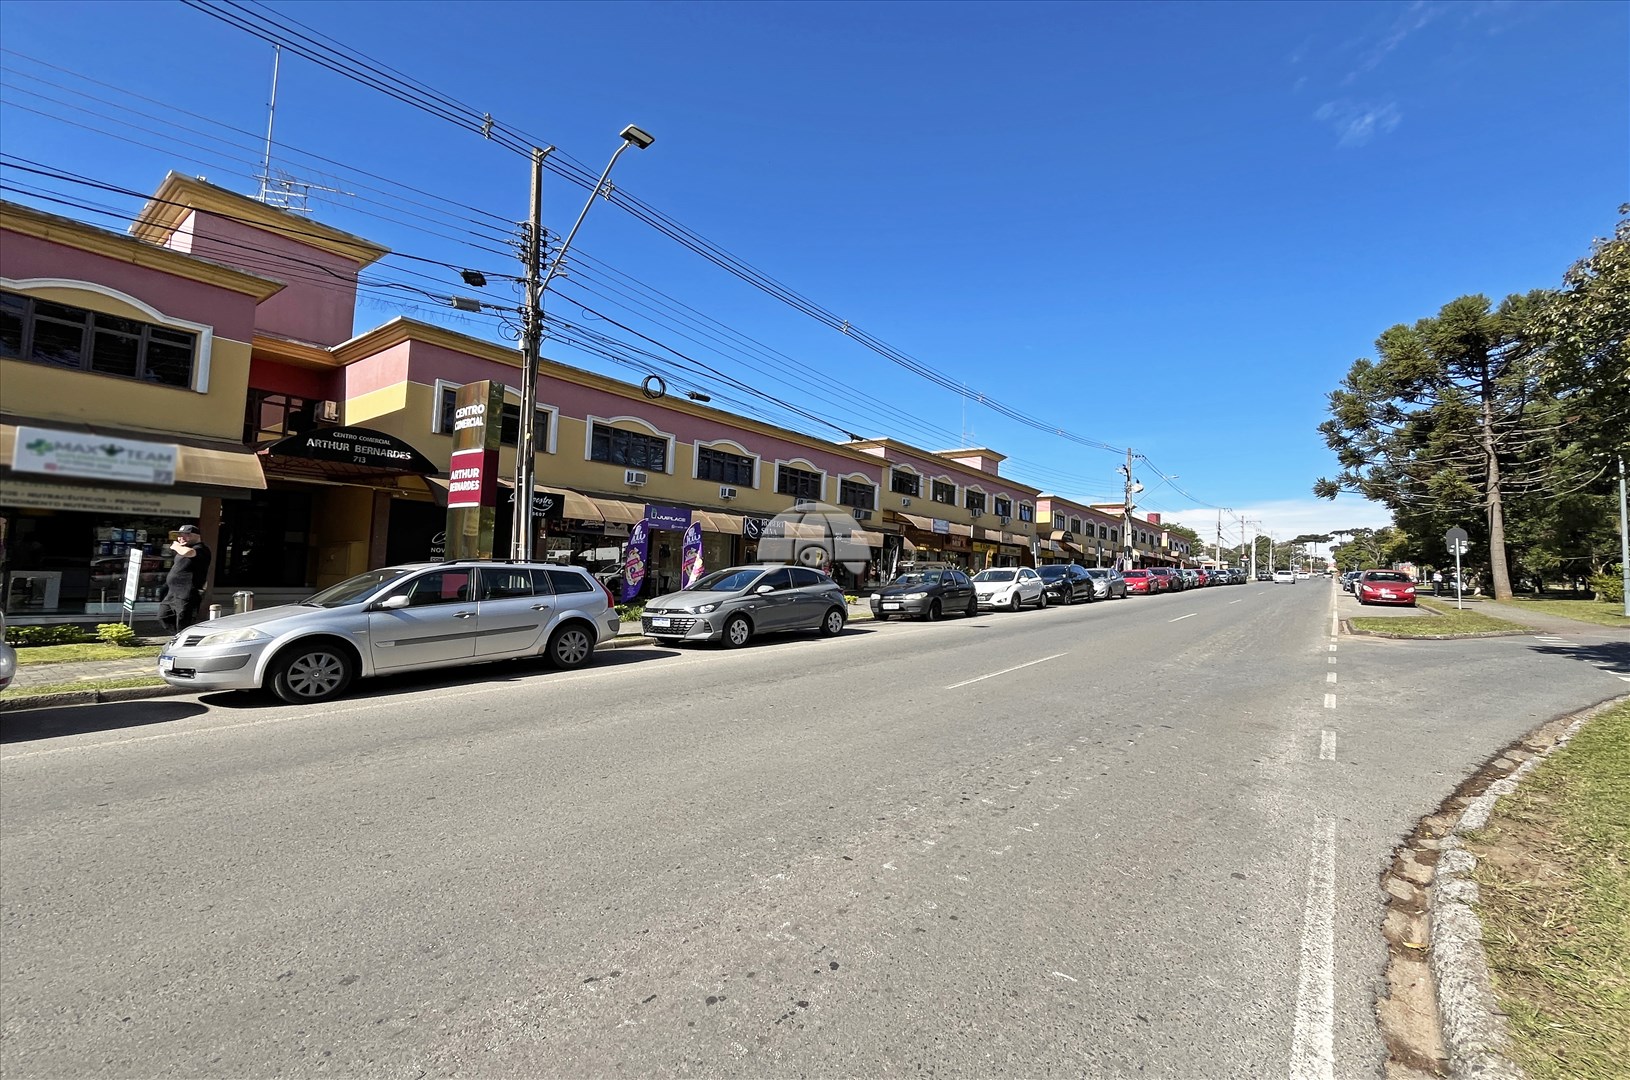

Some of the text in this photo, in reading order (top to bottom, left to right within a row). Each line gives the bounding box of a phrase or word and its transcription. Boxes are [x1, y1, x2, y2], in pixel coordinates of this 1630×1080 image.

[455, 404, 485, 419] CENTRO
[454, 416, 484, 431] COMERCIAL
[332, 431, 391, 446] CENTRO COMERCIAL
[55, 441, 97, 454] MAX
[127, 449, 172, 463] TEAM
[306, 438, 412, 460] ARTHUR BERNARDES
[353, 456, 366, 464] 713
[450, 467, 480, 481] ARTHUR
[449, 480, 480, 493] BERNARDES
[760, 527, 777, 535] SILVA
